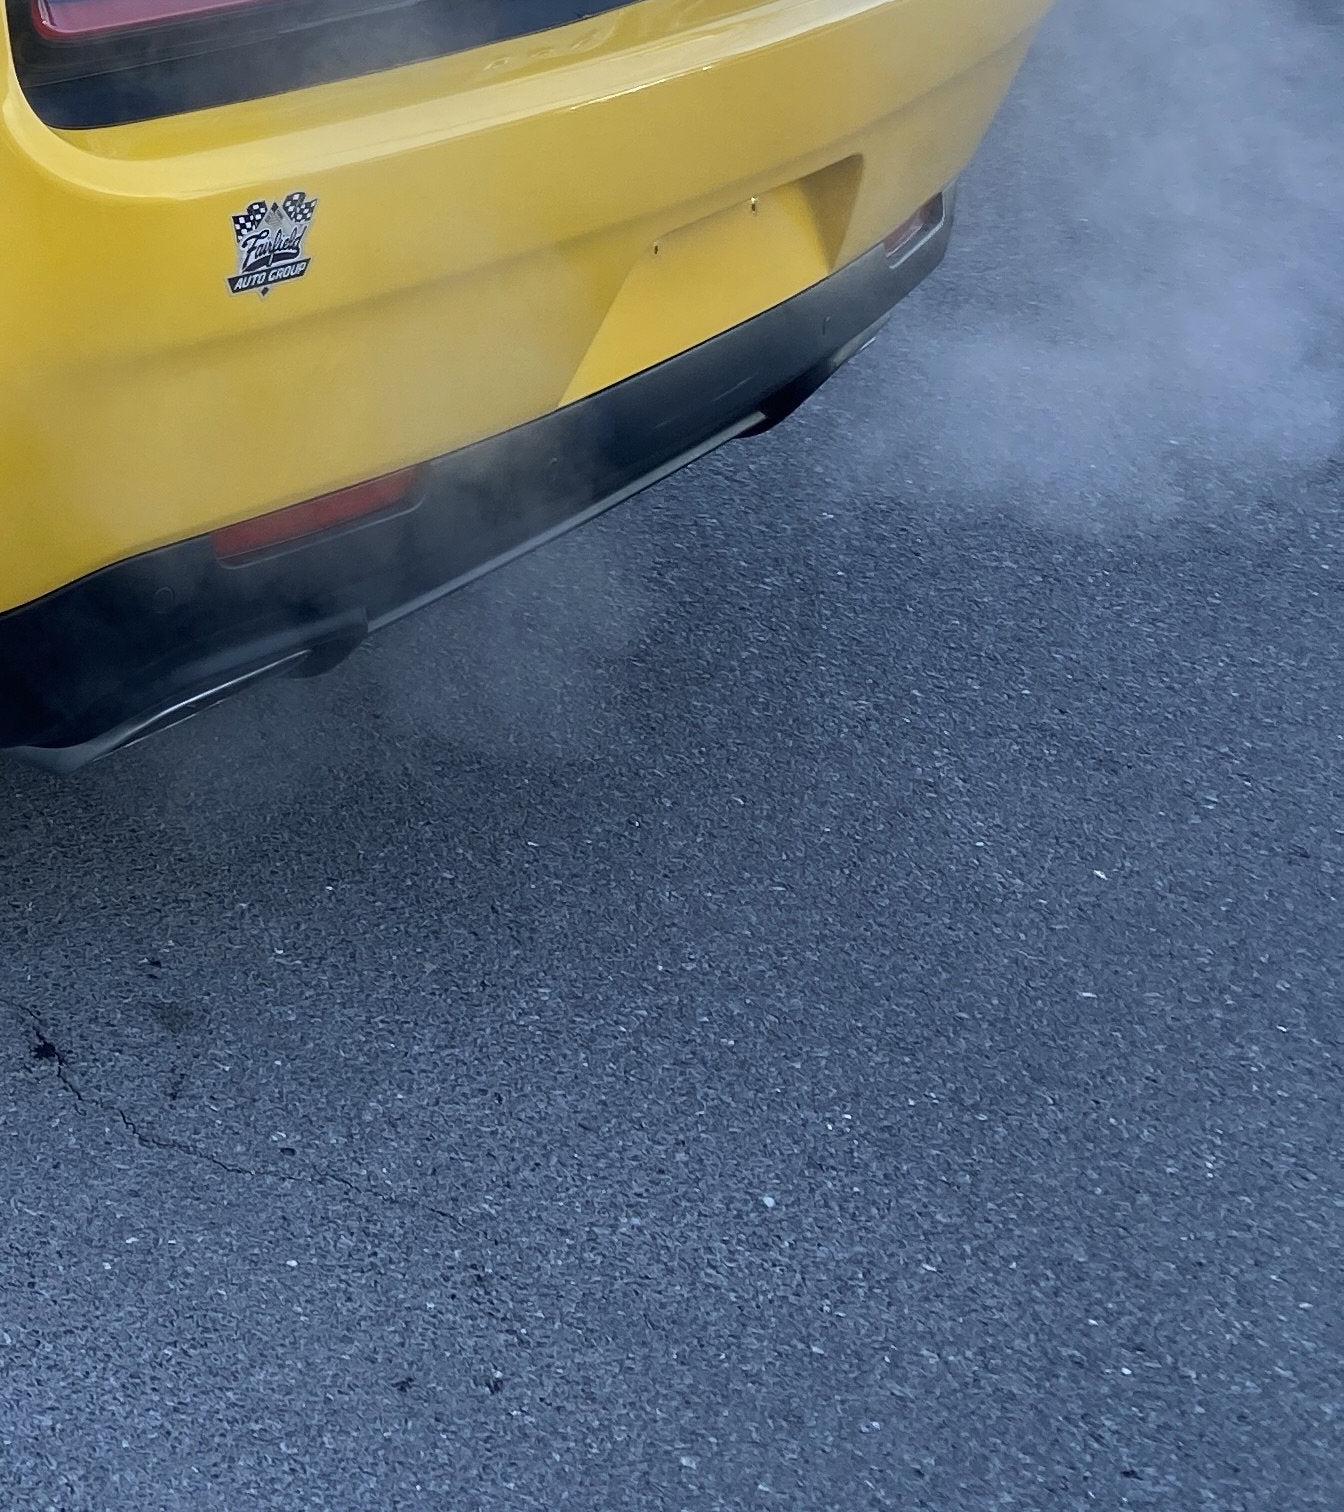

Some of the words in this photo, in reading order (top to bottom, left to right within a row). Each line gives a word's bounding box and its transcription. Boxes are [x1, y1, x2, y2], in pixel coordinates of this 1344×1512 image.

[241, 226, 307, 273] Fairfield
[233, 272, 266, 291] AUTO
[268, 262, 307, 281] GROUP
